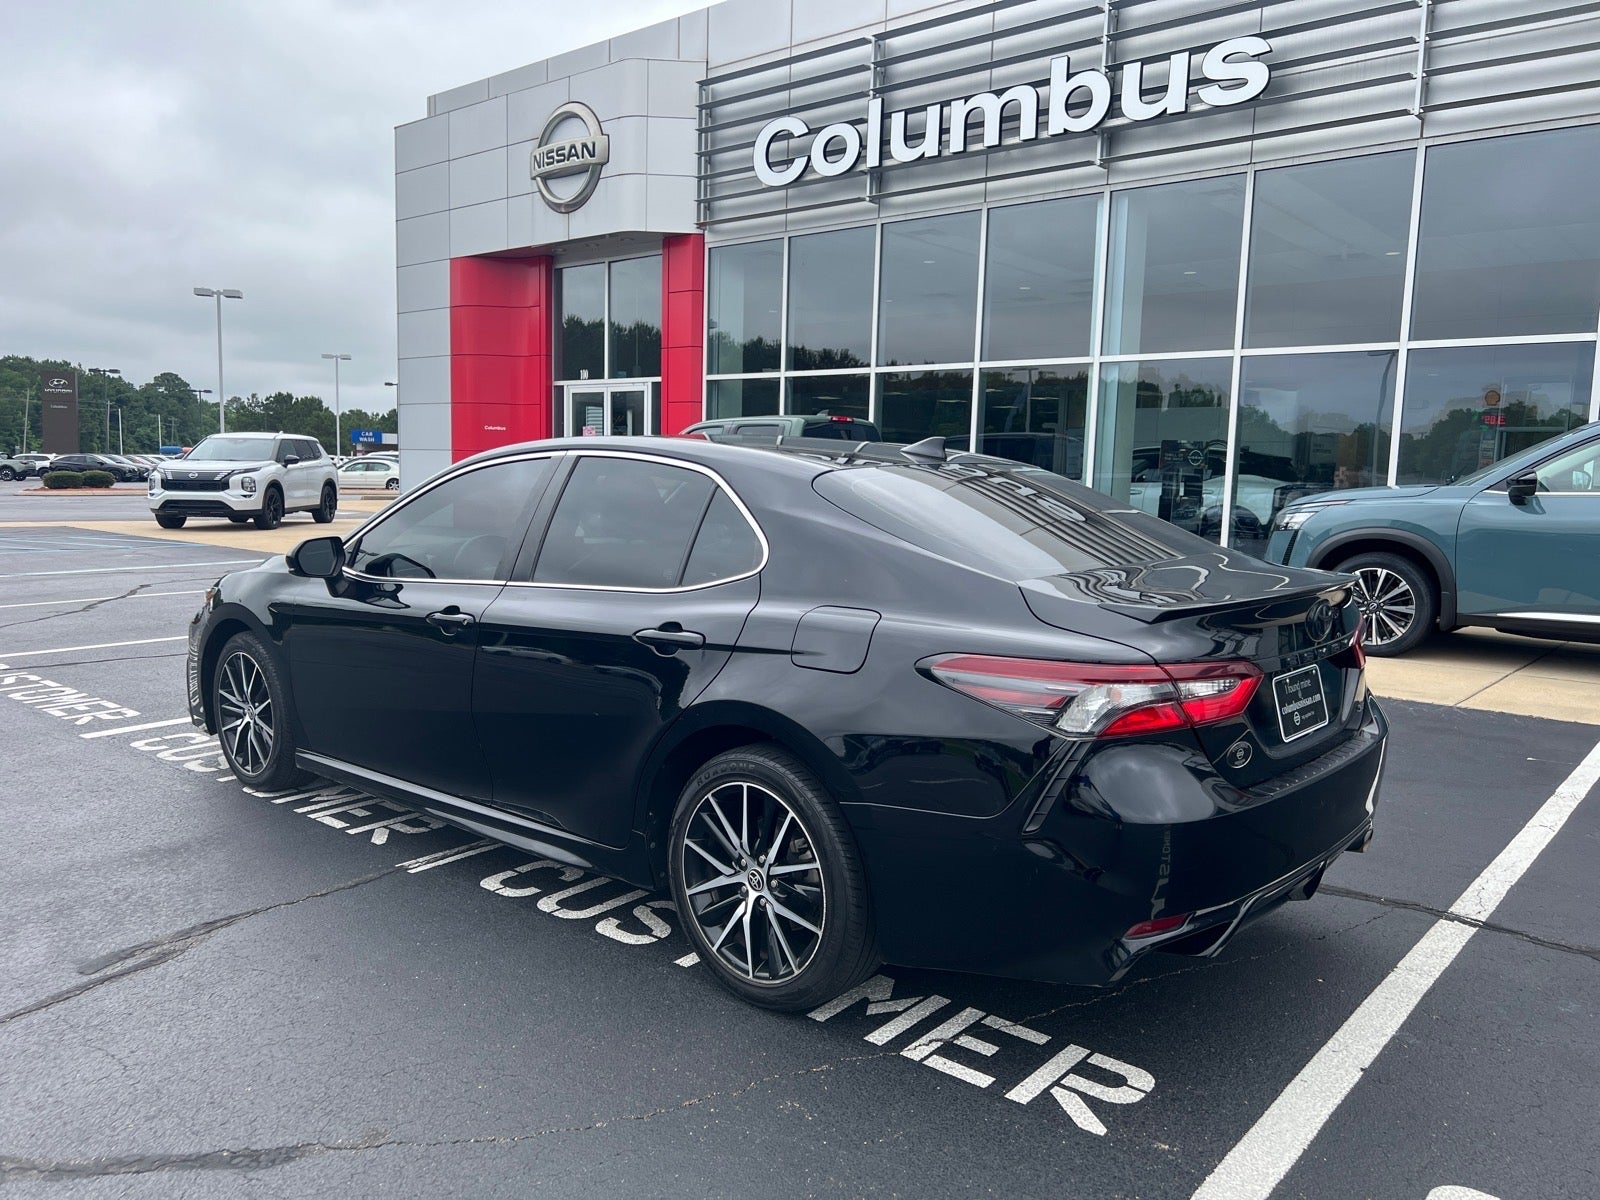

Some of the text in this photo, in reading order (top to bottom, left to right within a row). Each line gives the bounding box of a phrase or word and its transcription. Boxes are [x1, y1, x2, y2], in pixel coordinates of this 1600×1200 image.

[752, 36, 1272, 187] Columbus
[533, 141, 596, 171] NISSAN
[1282, 693, 1322, 715] columbusnissan.com
